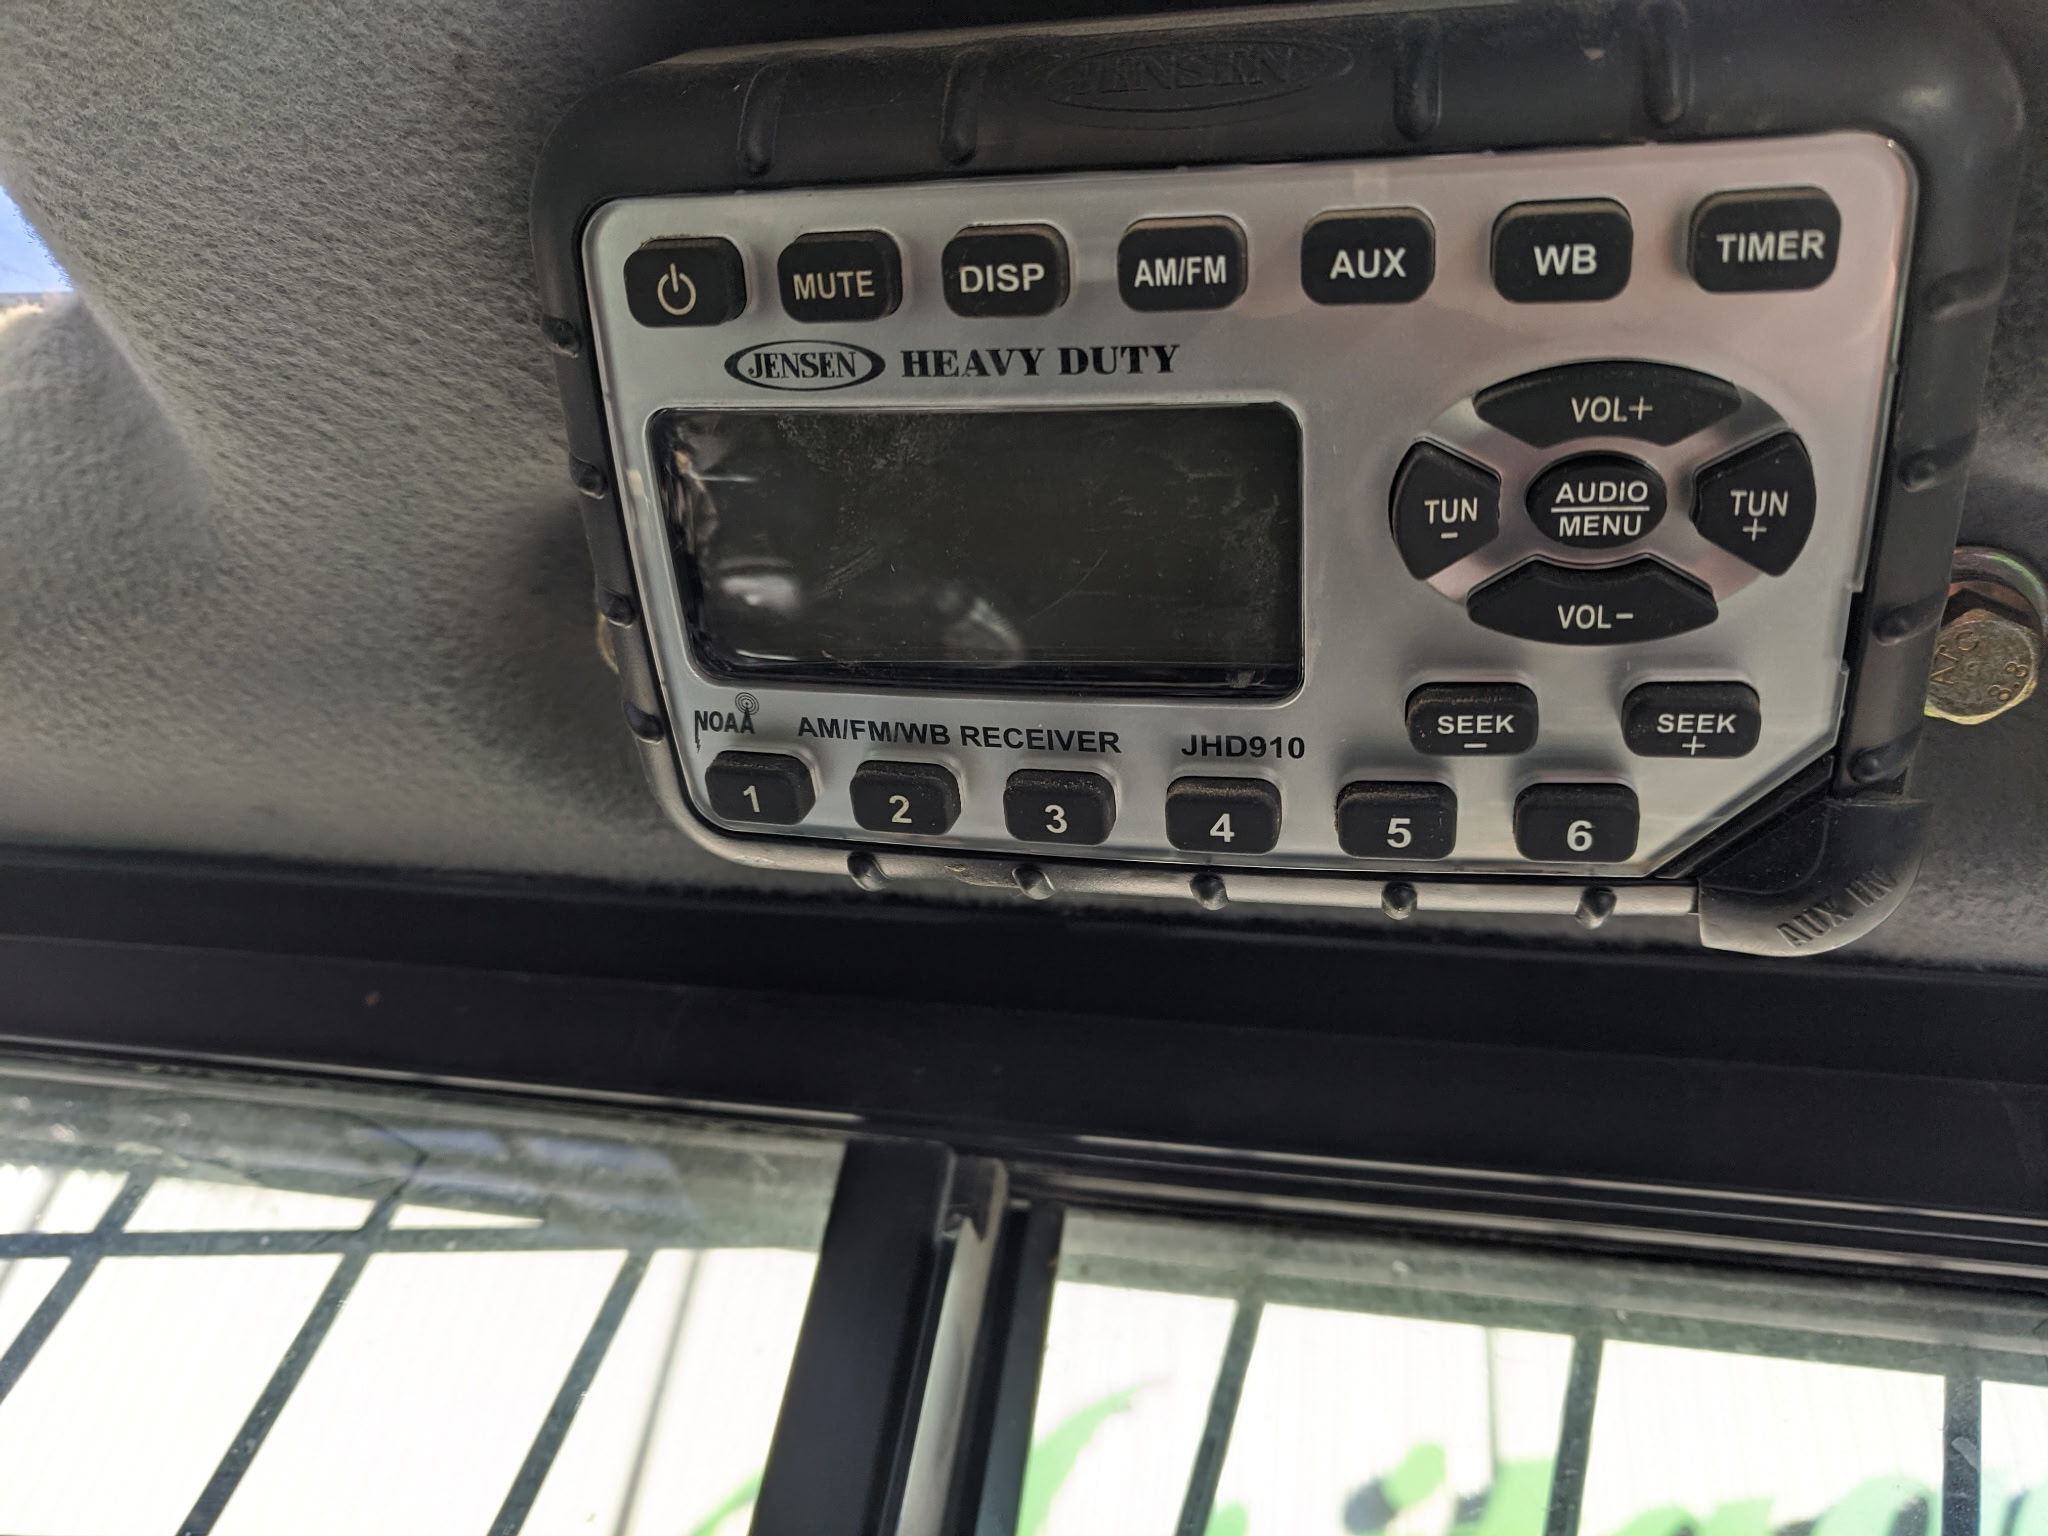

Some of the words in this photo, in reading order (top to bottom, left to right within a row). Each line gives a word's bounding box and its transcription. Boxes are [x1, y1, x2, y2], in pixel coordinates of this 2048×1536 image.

[1533, 243, 1597, 276] WB
[1716, 229, 1826, 263] TIMER
[959, 263, 1045, 293] DISP
[1134, 255, 1227, 288] AM/FM
[1330, 247, 1406, 280] AUX
[793, 270, 875, 300] MUTE
[746, 351, 858, 380] JENSEN
[900, 347, 1045, 378] HEAVY
[1058, 344, 1180, 375] DUTY
[1571, 396, 1653, 423] VOL+
[1555, 480, 1648, 504] AUDIO
[1730, 490, 1789, 517] TUN
[1424, 497, 1478, 524] TUN
[1559, 514, 1642, 537] MENU
[695, 708, 756, 738] NOAA
[797, 716, 951, 746] AM/FM/WB
[959, 725, 1122, 754] RECEIVER
[1437, 714, 1515, 735] SEEK
[1656, 713, 1737, 734] SEEK
[1181, 734, 1305, 760] JHD910
[742, 785, 761, 814] 1
[889, 795, 912, 825] 2
[1044, 804, 1068, 835] 3
[1209, 814, 1235, 843] 4
[1386, 818, 1412, 848] 5
[1566, 820, 1593, 851] 6
[1777, 899, 1853, 948] AUX
[1845, 868, 1898, 908] IN
